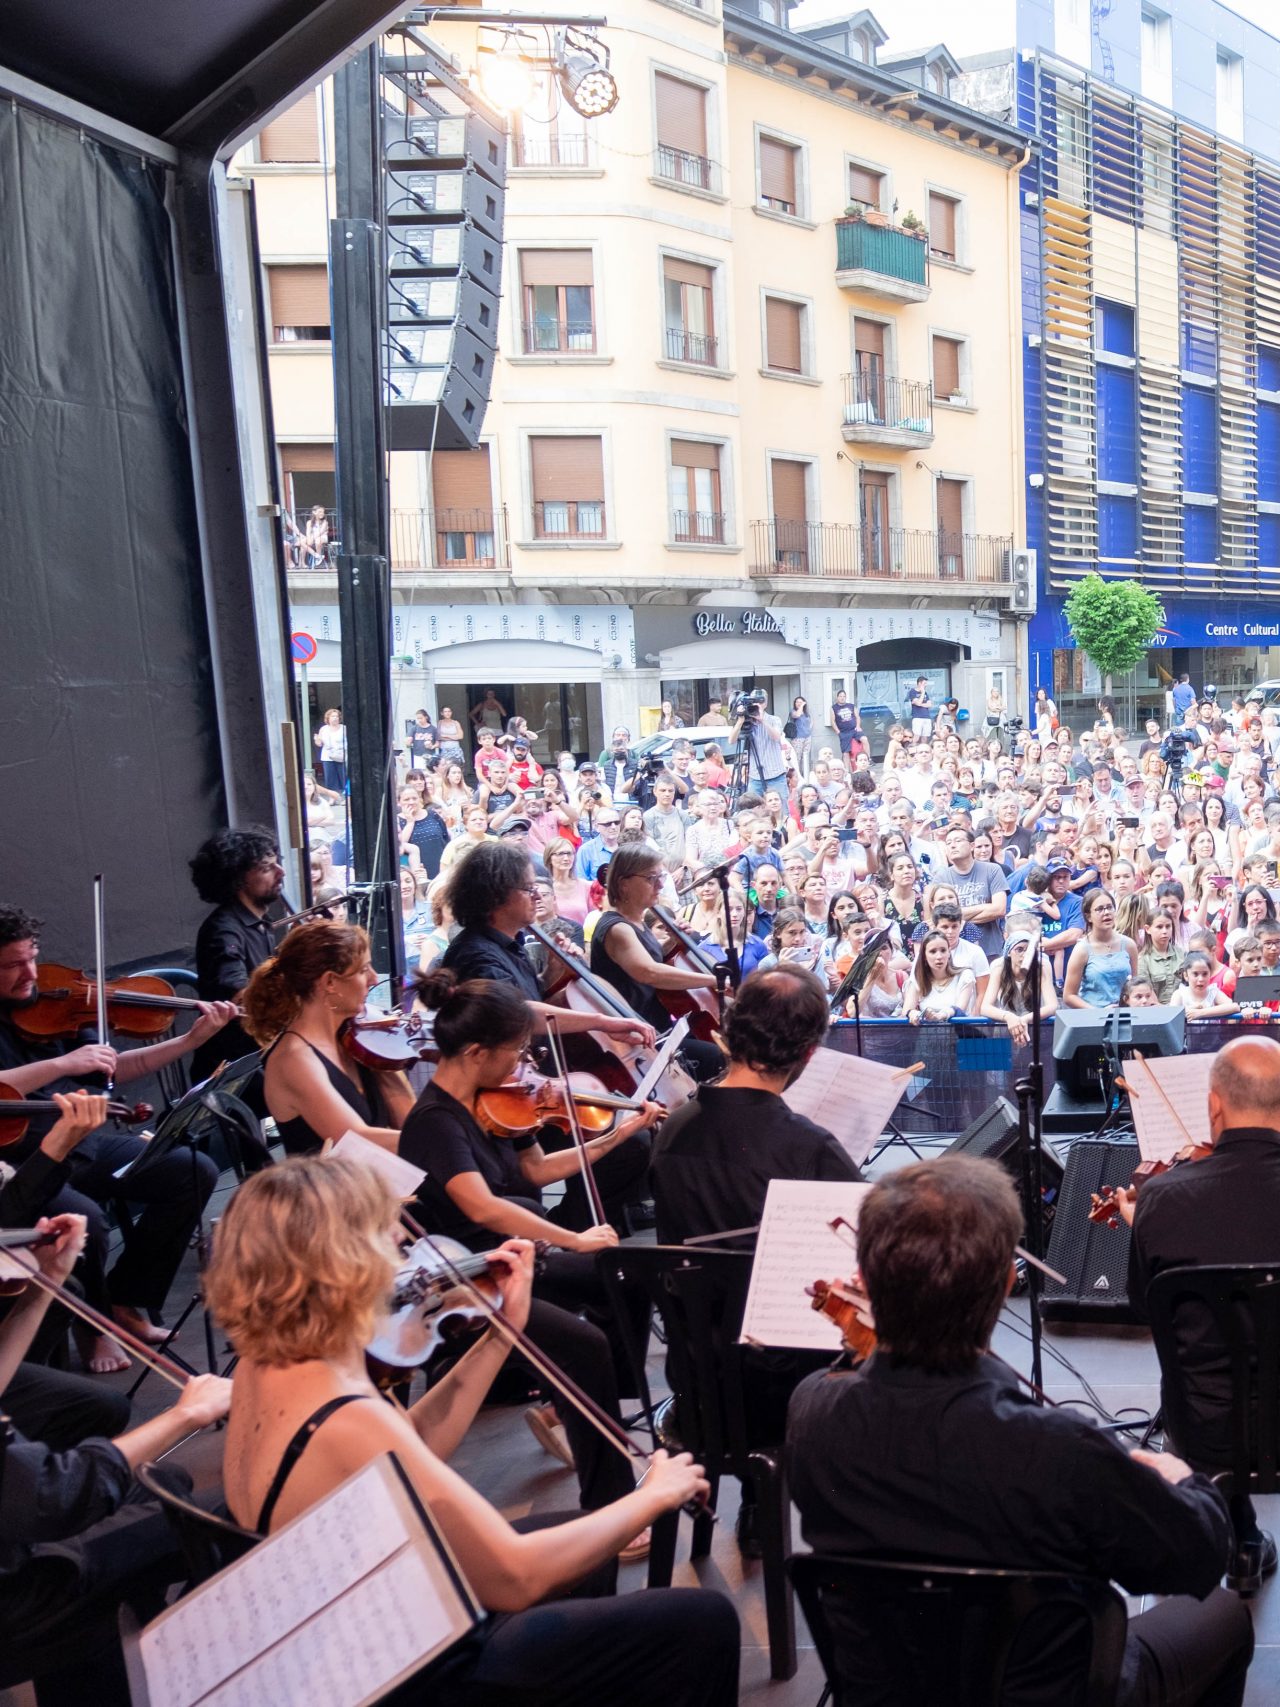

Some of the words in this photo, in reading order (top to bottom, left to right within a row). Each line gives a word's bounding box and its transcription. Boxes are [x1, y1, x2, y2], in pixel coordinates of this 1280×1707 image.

[697, 611, 735, 636] Bella
[1206, 623, 1238, 636] Centre
[1243, 623, 1279, 636] Cultural
